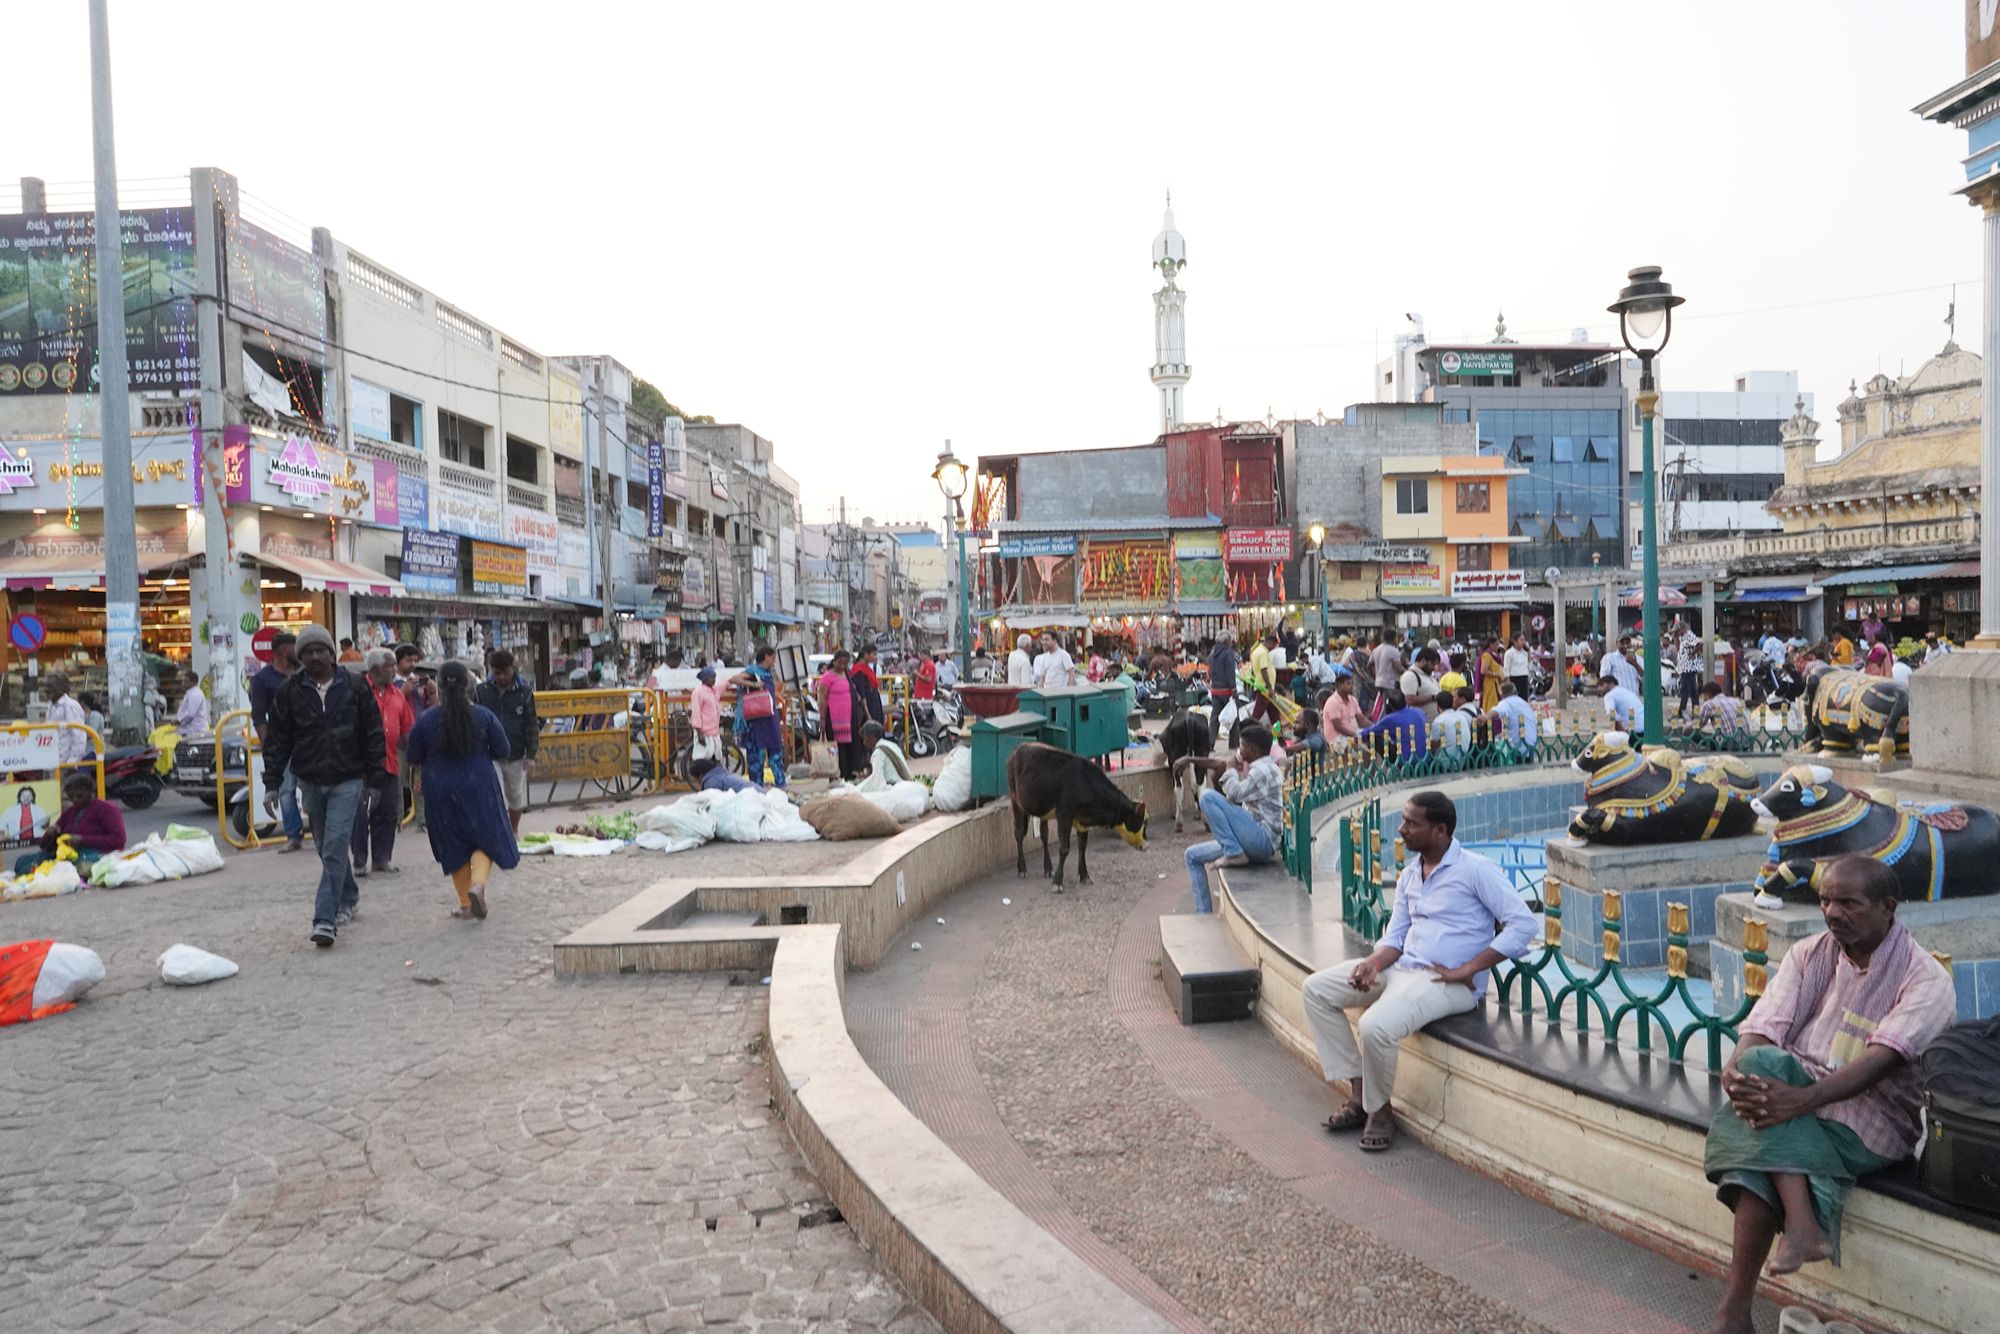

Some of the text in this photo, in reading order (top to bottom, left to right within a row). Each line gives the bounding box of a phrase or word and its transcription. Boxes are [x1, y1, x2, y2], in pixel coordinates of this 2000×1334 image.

[135, 359, 171, 371] 82142
[136, 371, 172, 384] 97419
[271, 458, 331, 482] Mahalakshmi
[1003, 543, 1074, 555] New Jupiter Store
[1231, 546, 1290, 554] JUPITER STORES
